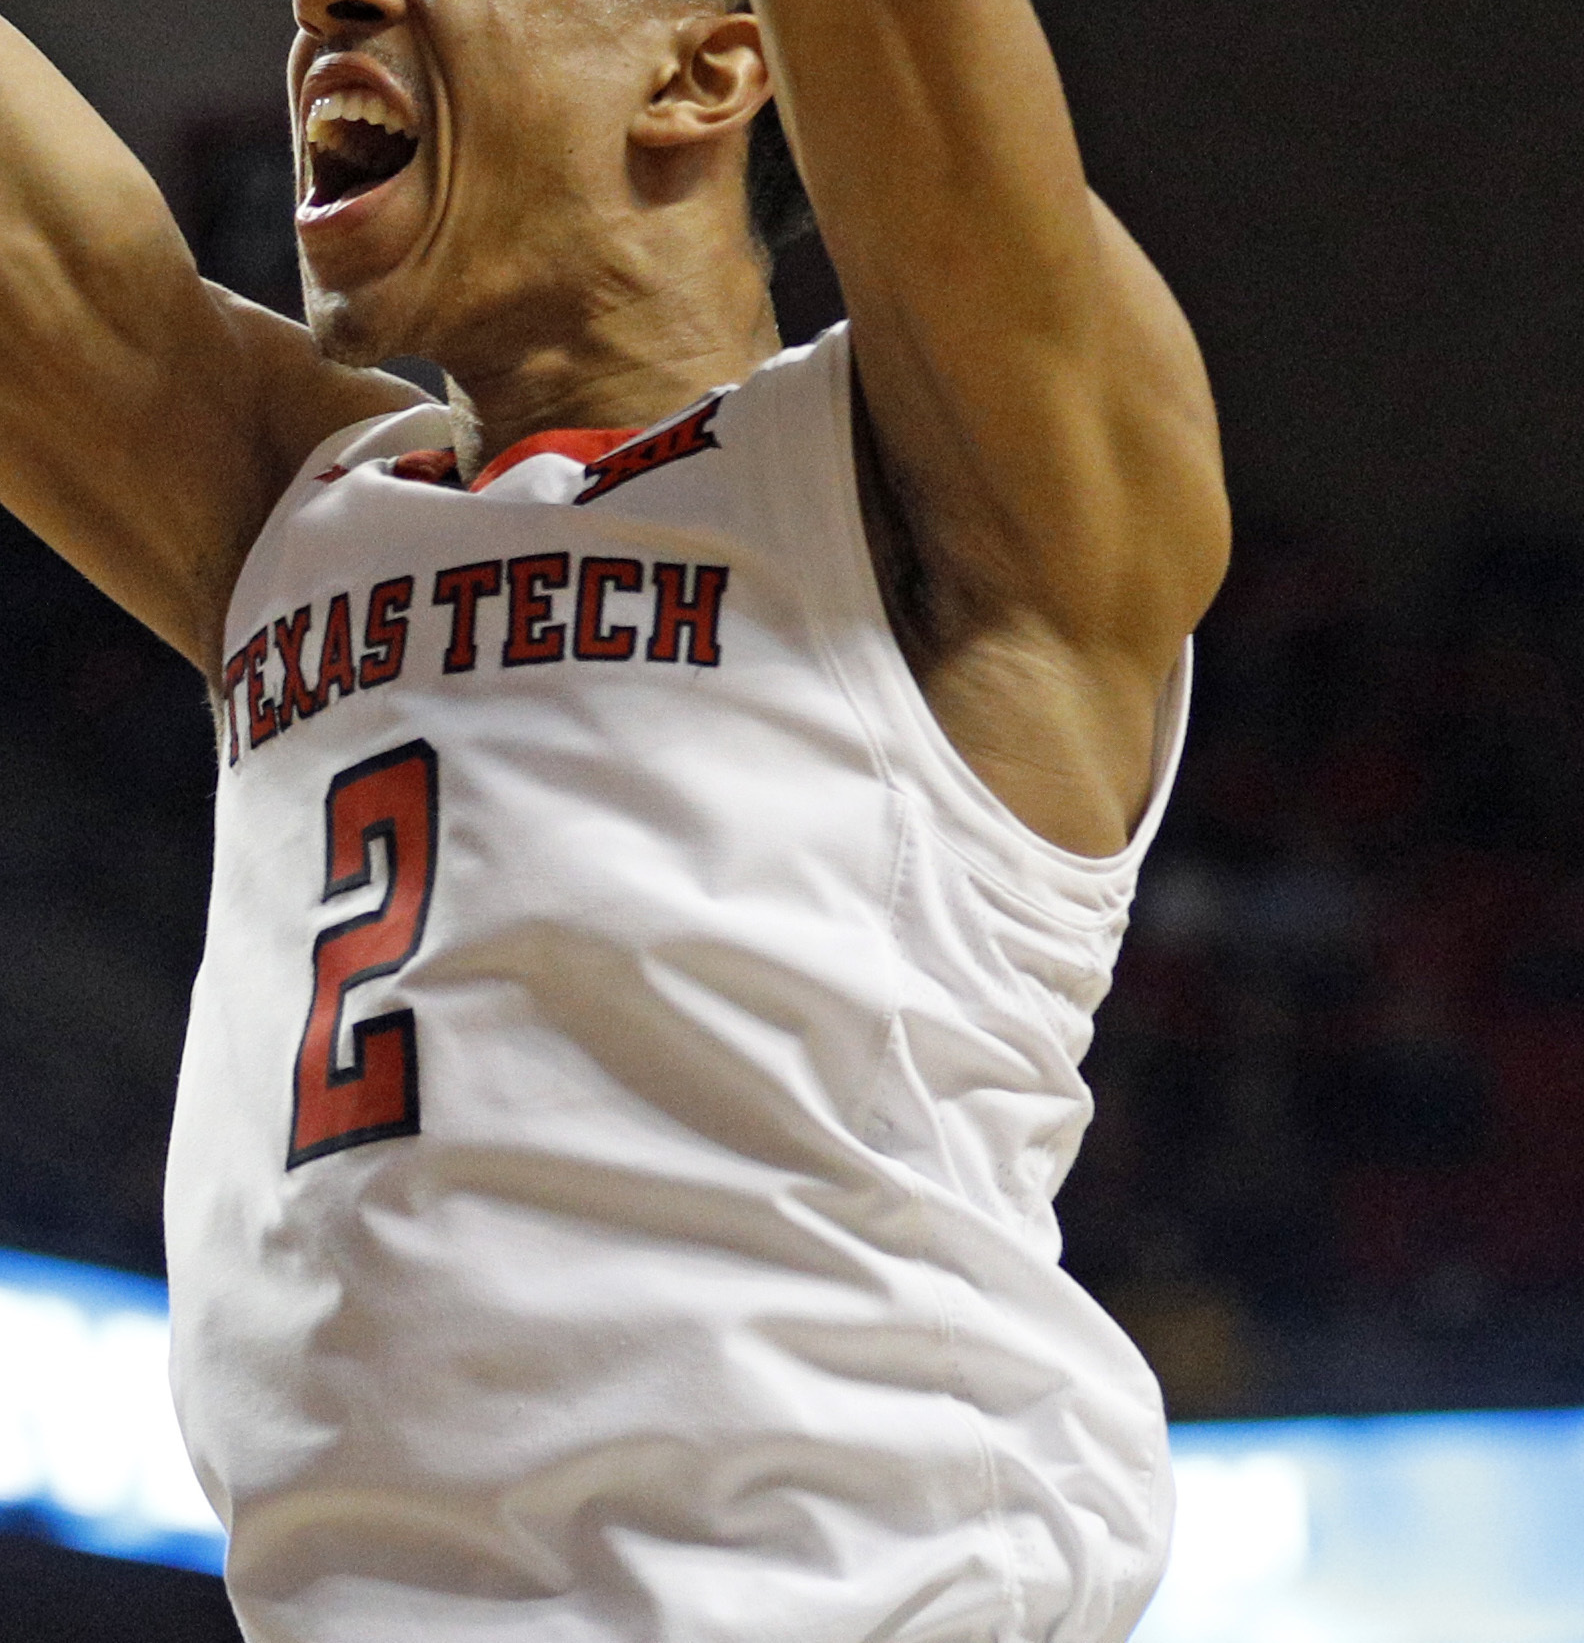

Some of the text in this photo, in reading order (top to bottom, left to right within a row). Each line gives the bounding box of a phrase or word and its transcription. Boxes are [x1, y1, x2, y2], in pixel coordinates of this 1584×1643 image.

[223, 551, 730, 769] TEXAS TECH
[285, 737, 440, 1172] 2
